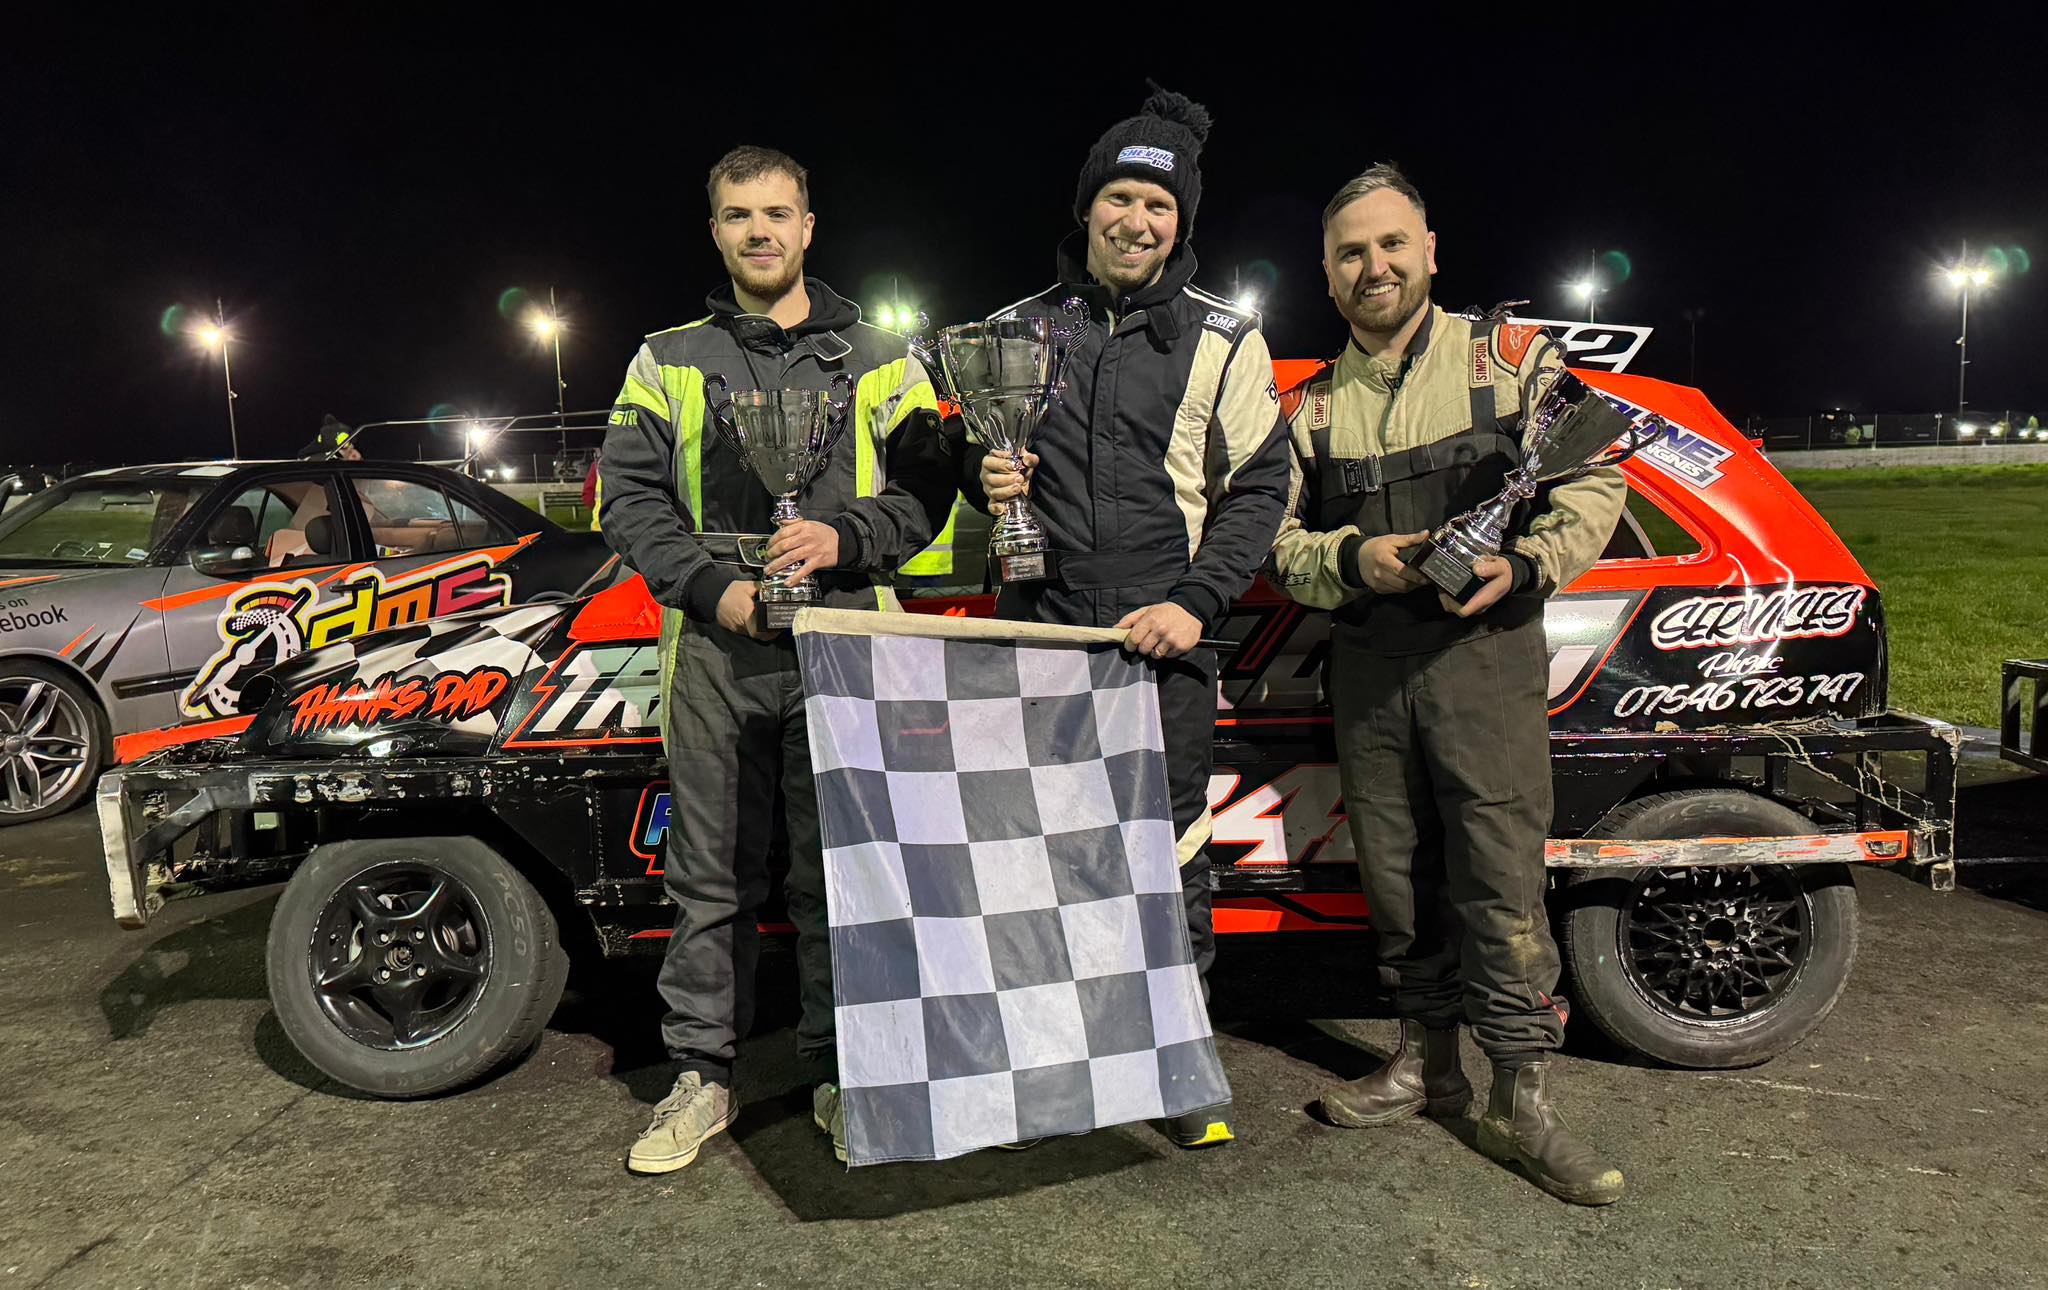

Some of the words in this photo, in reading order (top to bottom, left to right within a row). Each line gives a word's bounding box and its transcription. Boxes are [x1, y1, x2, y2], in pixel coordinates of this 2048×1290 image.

[1205, 313, 1238, 330] OMP
[1475, 342, 1488, 381] SIMPSON
[1314, 387, 1327, 424] SIMPSON
[1643, 440, 1705, 478] NGINES
[0, 603, 69, 634] ebook
[8, 597, 29, 608] on
[1654, 587, 1864, 645] SERVICES
[1698, 648, 1784, 679] Phone
[288, 674, 428, 736] THANKS
[425, 669, 508, 718] DAD
[1613, 681, 1737, 718] 07546
[1740, 673, 1804, 710] 723
[1806, 671, 1865, 705] 747
